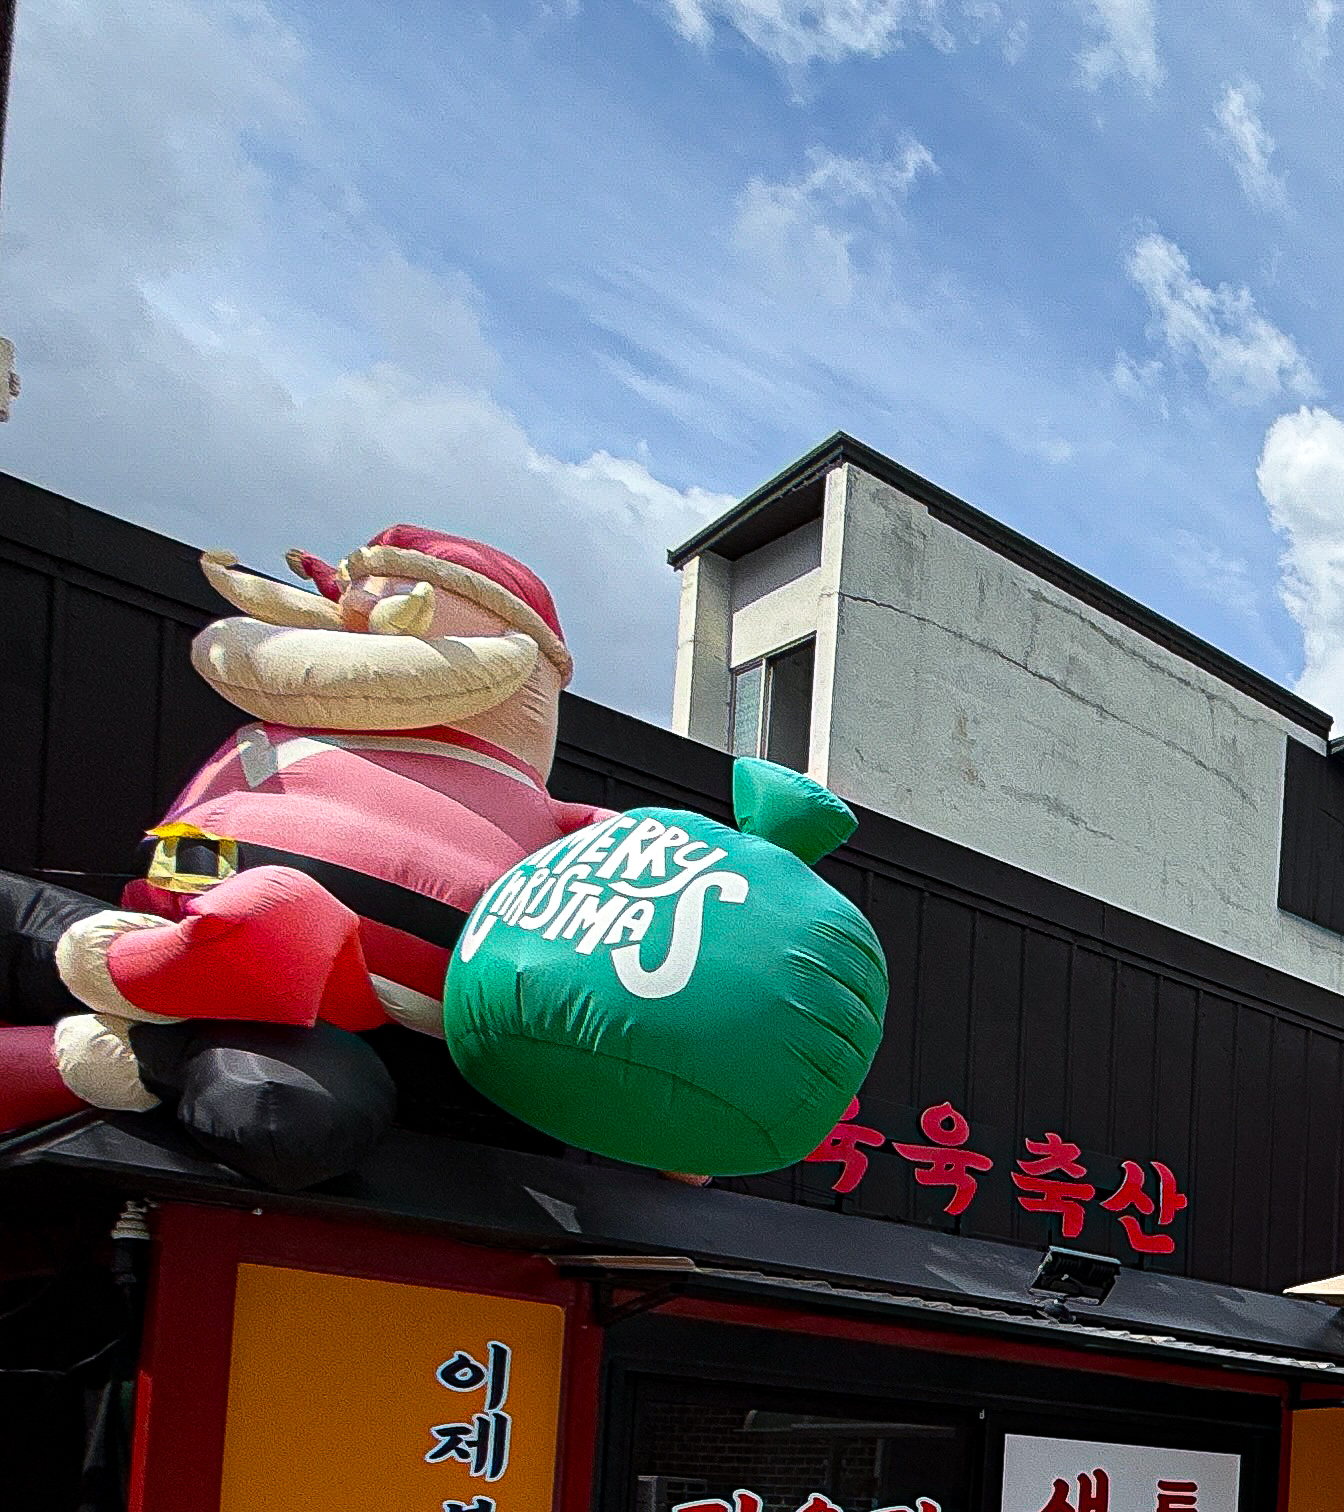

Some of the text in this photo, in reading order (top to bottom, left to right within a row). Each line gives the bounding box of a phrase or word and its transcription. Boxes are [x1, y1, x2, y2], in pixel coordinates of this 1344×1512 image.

[522, 815, 728, 898] MERRY
[459, 862, 750, 999] CHRISTMAS
[1010, 1132, 1188, 1254] 축산
[423, 1340, 513, 1483] 이제
